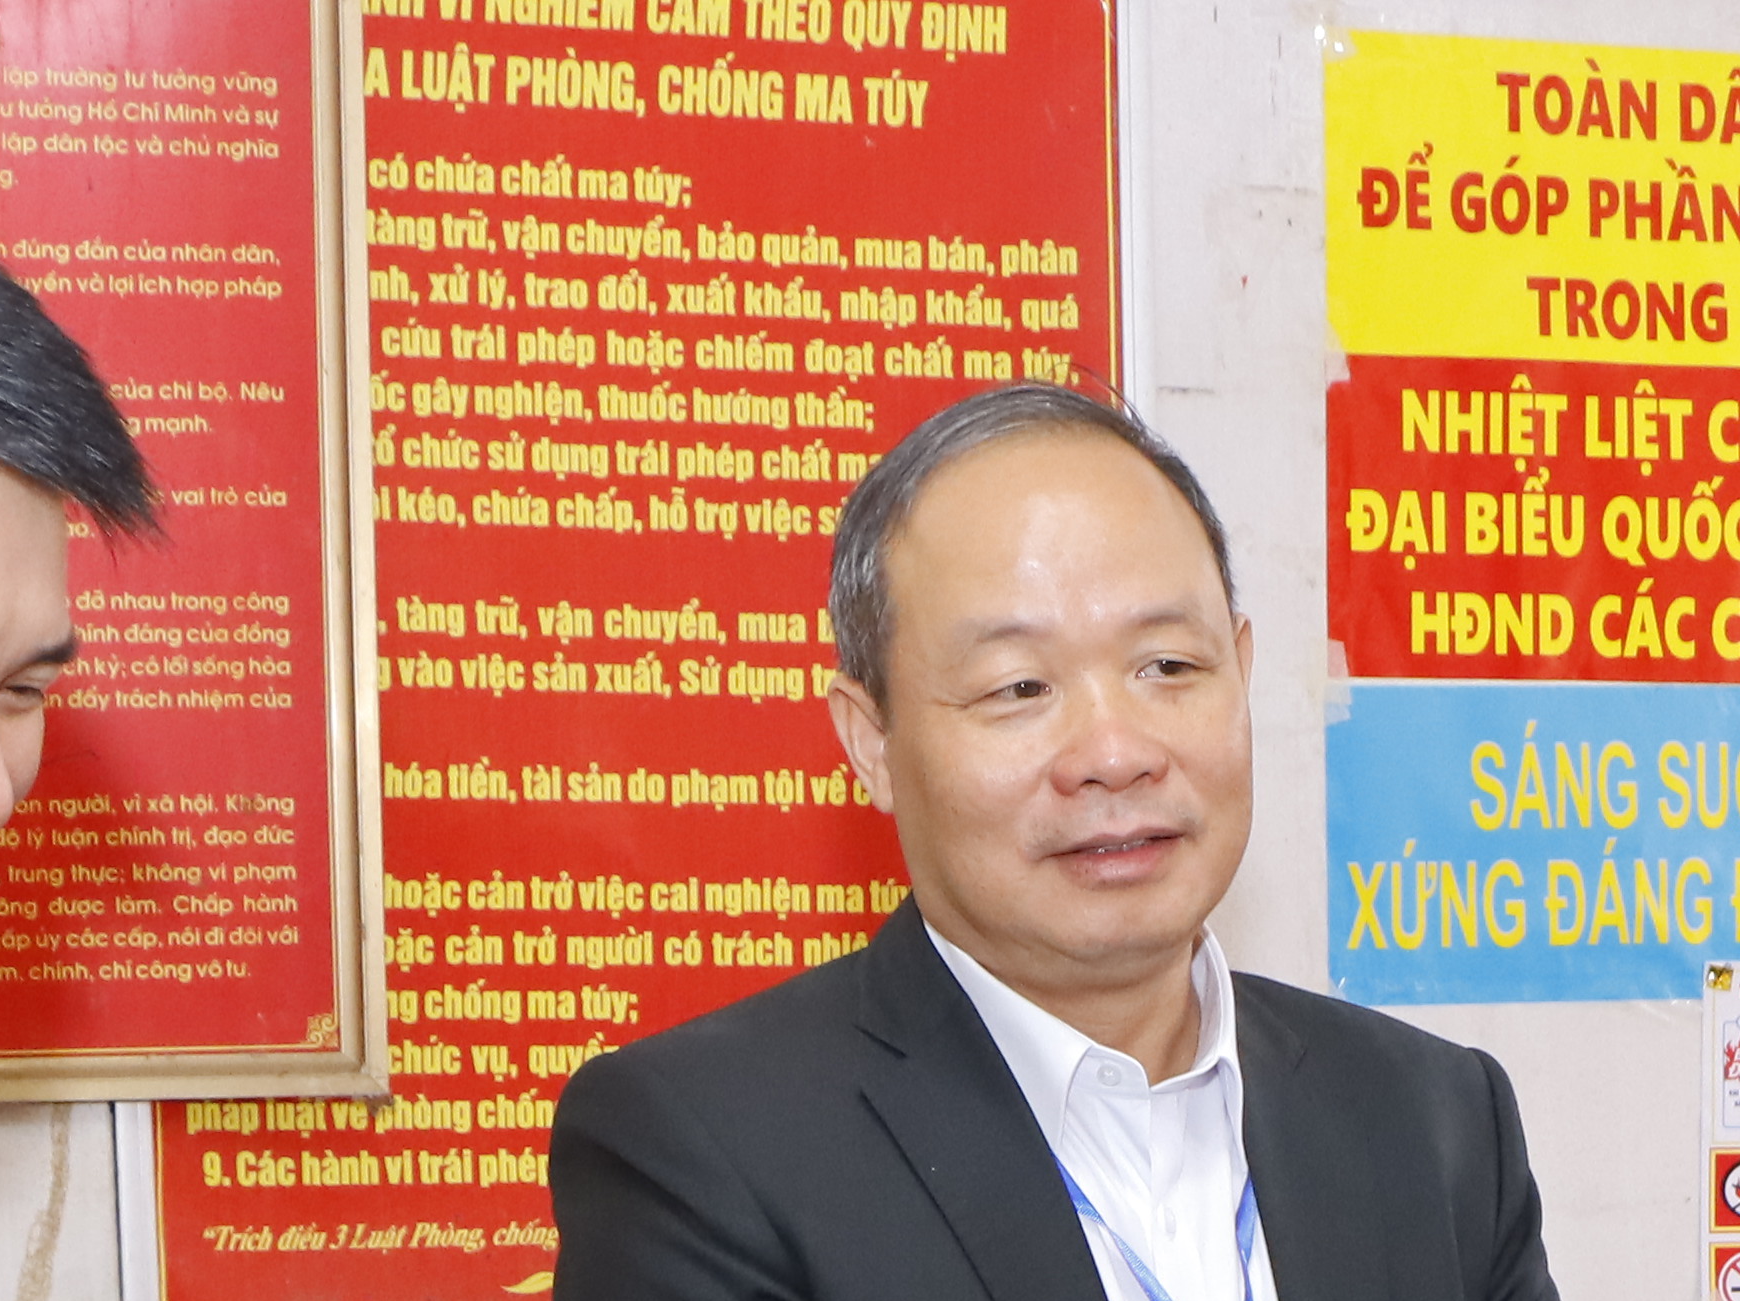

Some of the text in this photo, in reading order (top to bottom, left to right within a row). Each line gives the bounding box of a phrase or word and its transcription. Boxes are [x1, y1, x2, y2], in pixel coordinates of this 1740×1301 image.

[843, 0, 912, 51] QUY
[921, 2, 1006, 62] ĐỊNH
[402, 43, 928, 127] LUẬT PHÒNG, CHỐNG MA TÚY
[1497, 60, 1656, 141] TOÀN
[369, 153, 691, 207] có chứa chất ma túy;
[1357, 146, 1433, 230] ĐỂ
[1451, 156, 1569, 235] GÓP
[1527, 277, 1728, 343] TRONG
[1402, 378, 1567, 469] NHIỆT
[1586, 382, 1692, 472] LIỆT
[1346, 489, 1446, 568] ĐẠI
[1466, 467, 1584, 557] BIỂU
[1412, 592, 1574, 656] HĐND
[1590, 586, 1695, 659] CÁC
[1472, 722, 1638, 830] SÁNG
[1349, 846, 1525, 950] XỨNG
[1545, 844, 1712, 946] ĐÁNG
[203, 1152, 231, 1186] 9.
[236, 1151, 296, 1186] Các
[302, 1150, 379, 1186] hành
[385, 1150, 413, 1184] vi
[418, 1148, 473, 1184] trái
[203, 1226, 273, 1251] “Trích
[277, 1223, 327, 1251] điều
[329, 1224, 348, 1249] 3
[349, 1224, 407, 1252] Luật
[408, 1222, 486, 1252] Phòng,
